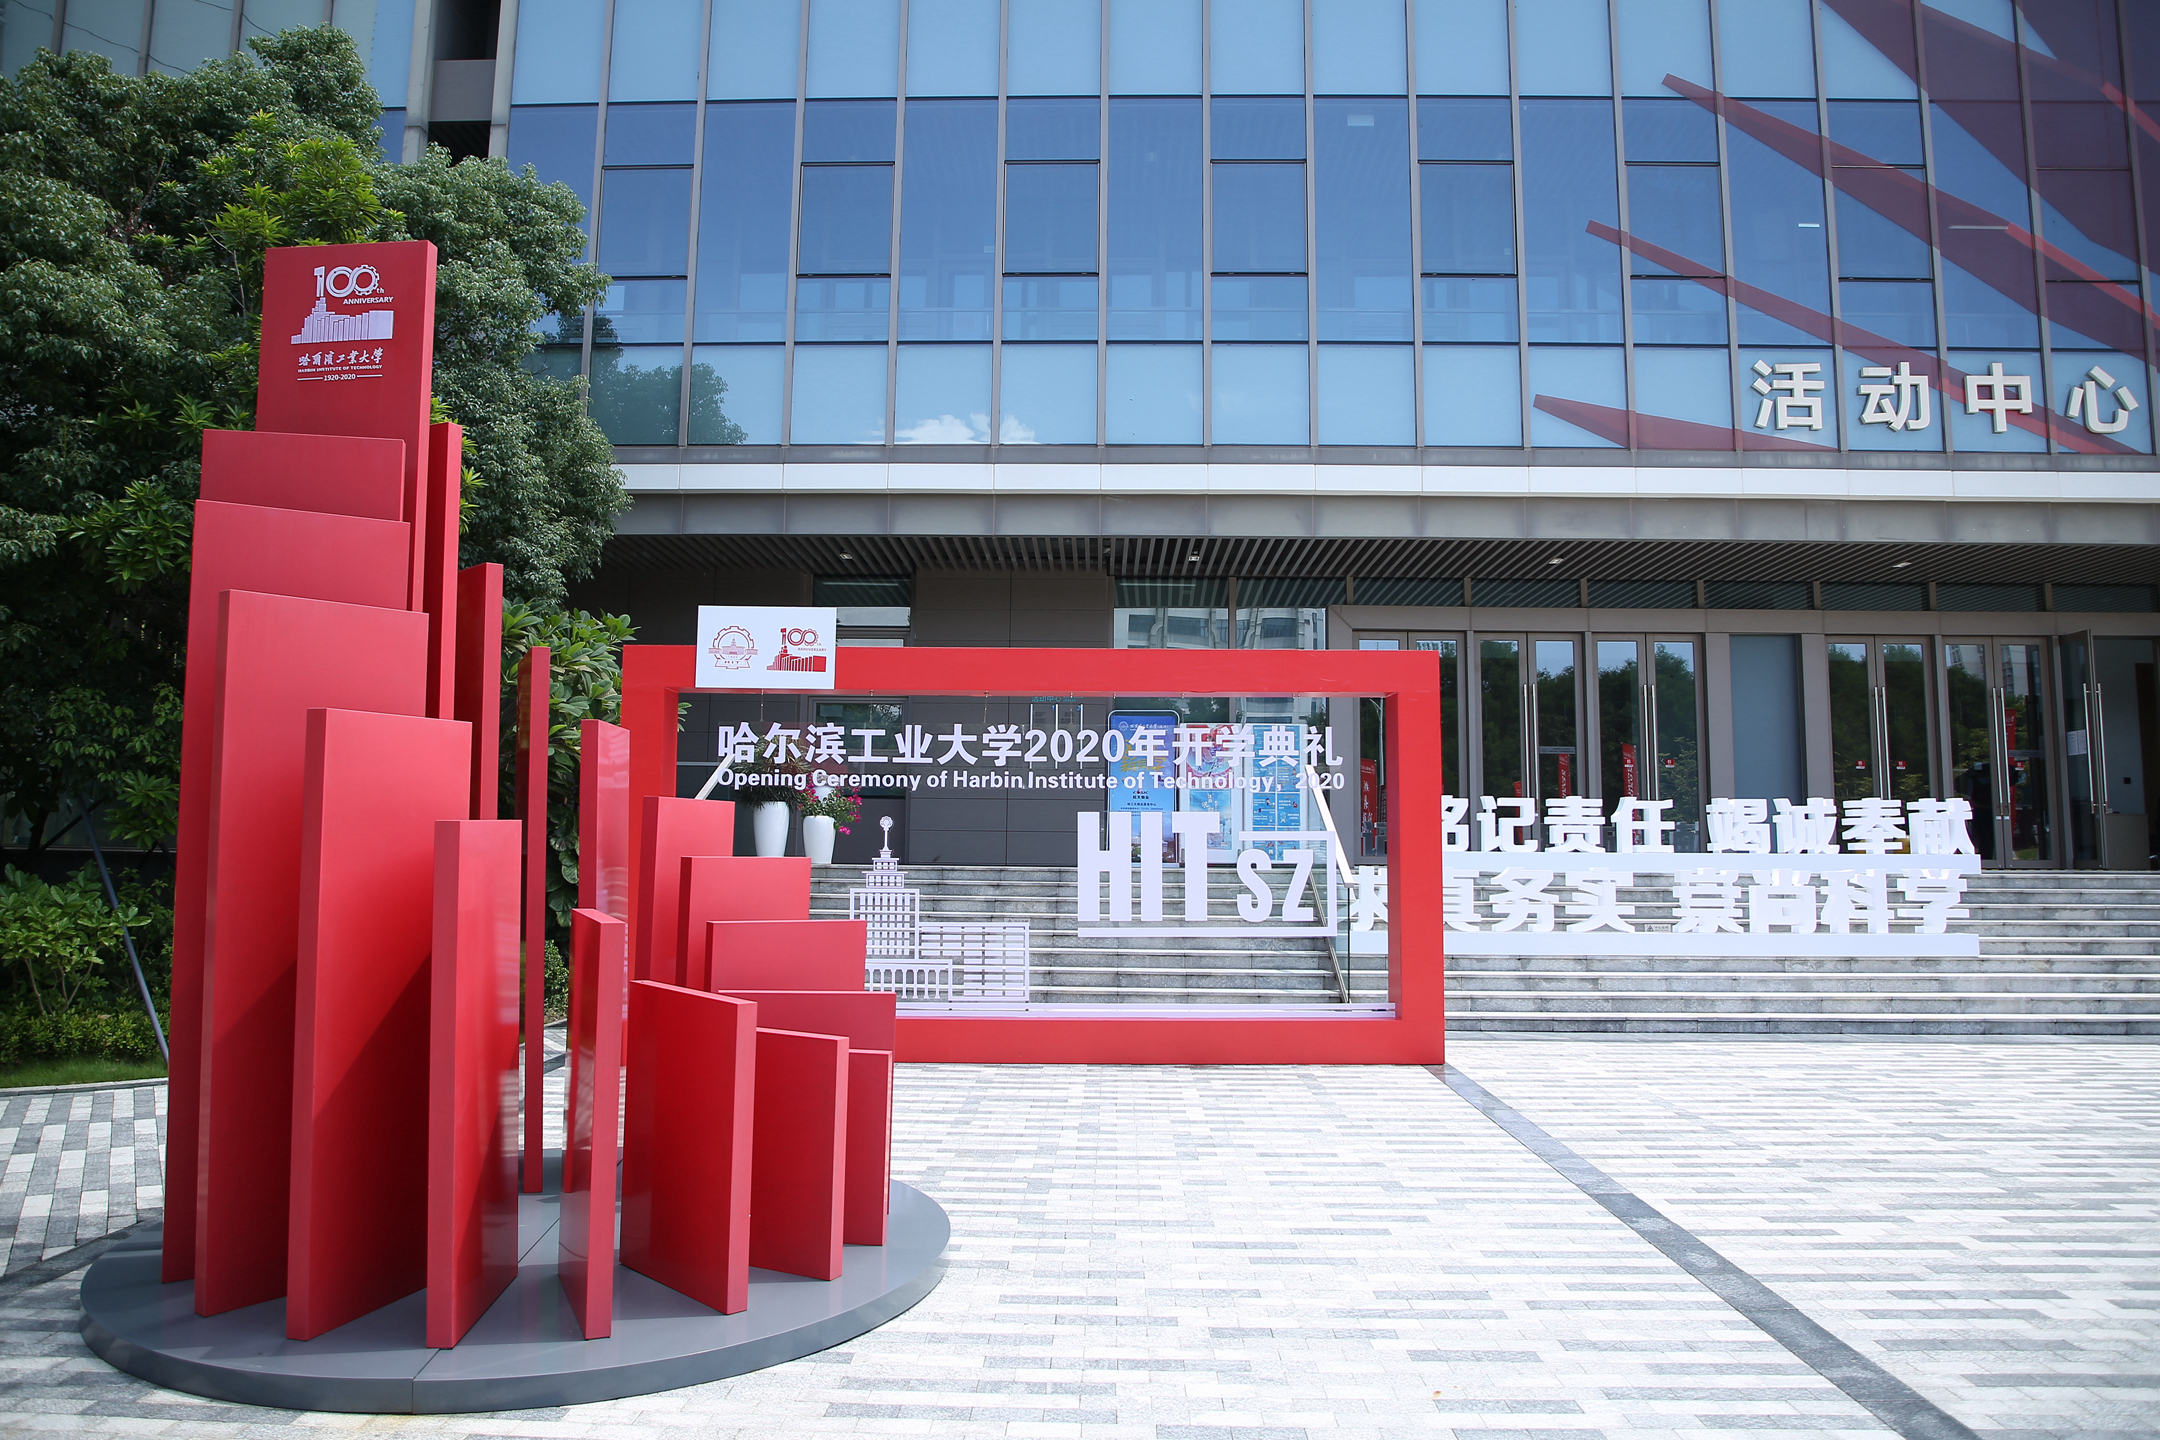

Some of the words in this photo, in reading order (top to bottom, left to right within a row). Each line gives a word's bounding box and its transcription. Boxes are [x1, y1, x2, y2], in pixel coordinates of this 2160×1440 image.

[342, 296, 394, 305] ANNIVERSARY
[324, 373, 356, 381] 1920-2020
[1752, 358, 2139, 434] 活动中心
[718, 722, 1343, 767] 哈尔滨工业大学2020年开学典礼
[718, 768, 807, 790] Opening
[813, 769, 921, 791] Ceremony
[930, 769, 948, 788] of
[953, 770, 1020, 789] Harbin
[1028, 771, 1118, 789] Institute
[1123, 771, 1145, 789] of
[1295, 773, 1345, 790] 2020
[1706, 797, 1976, 855] 竭诚奉献
[1077, 811, 1220, 922] HIT
[1672, 867, 1970, 934] 崇尚科学
